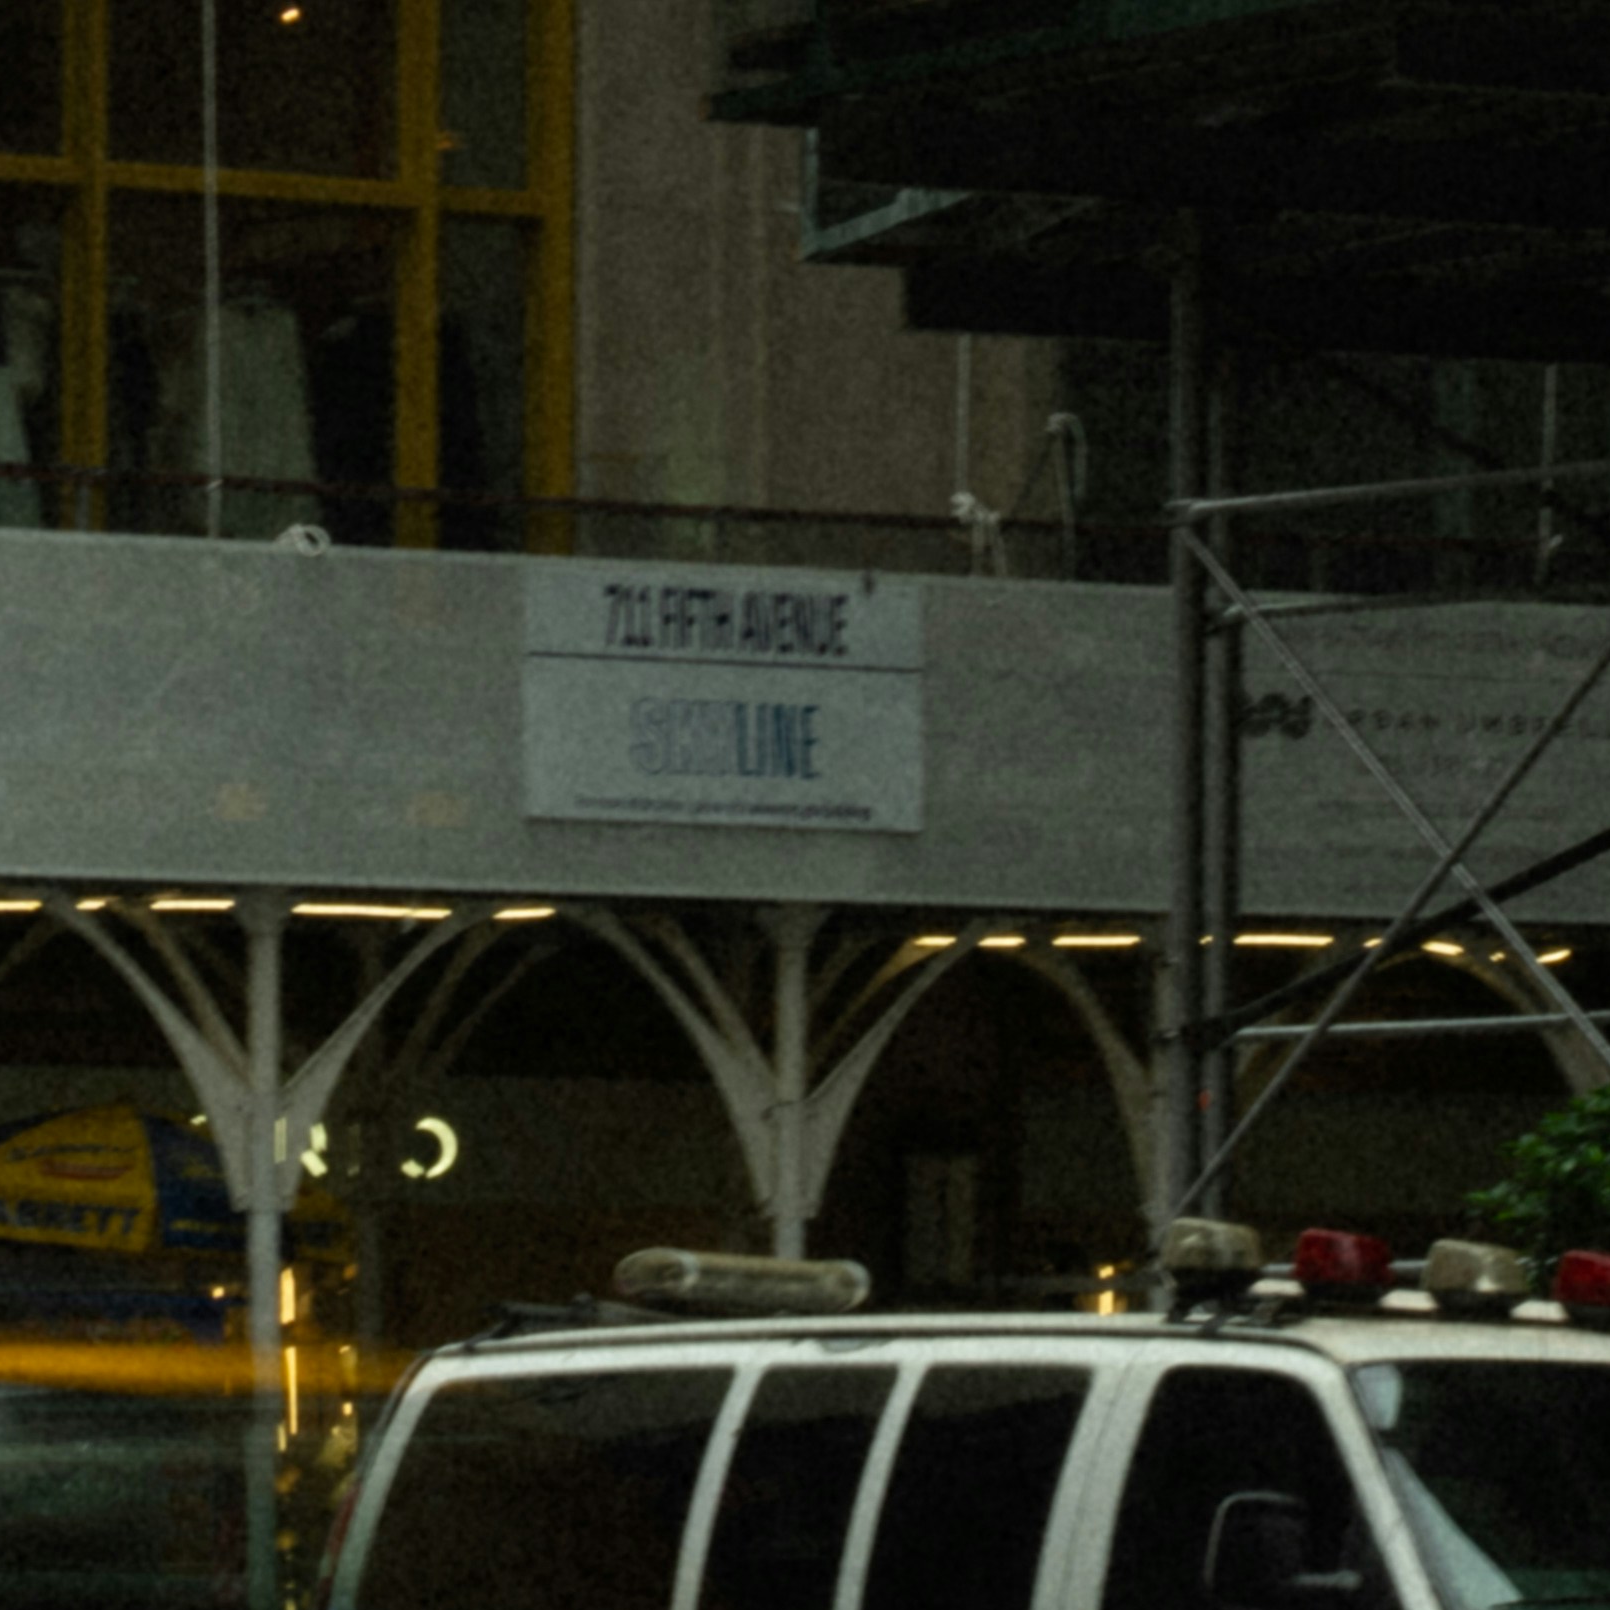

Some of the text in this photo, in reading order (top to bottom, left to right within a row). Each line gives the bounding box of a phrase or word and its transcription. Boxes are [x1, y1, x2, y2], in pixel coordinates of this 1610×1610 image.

[604, 584, 848, 655] 711 FIFTH AVENUE
